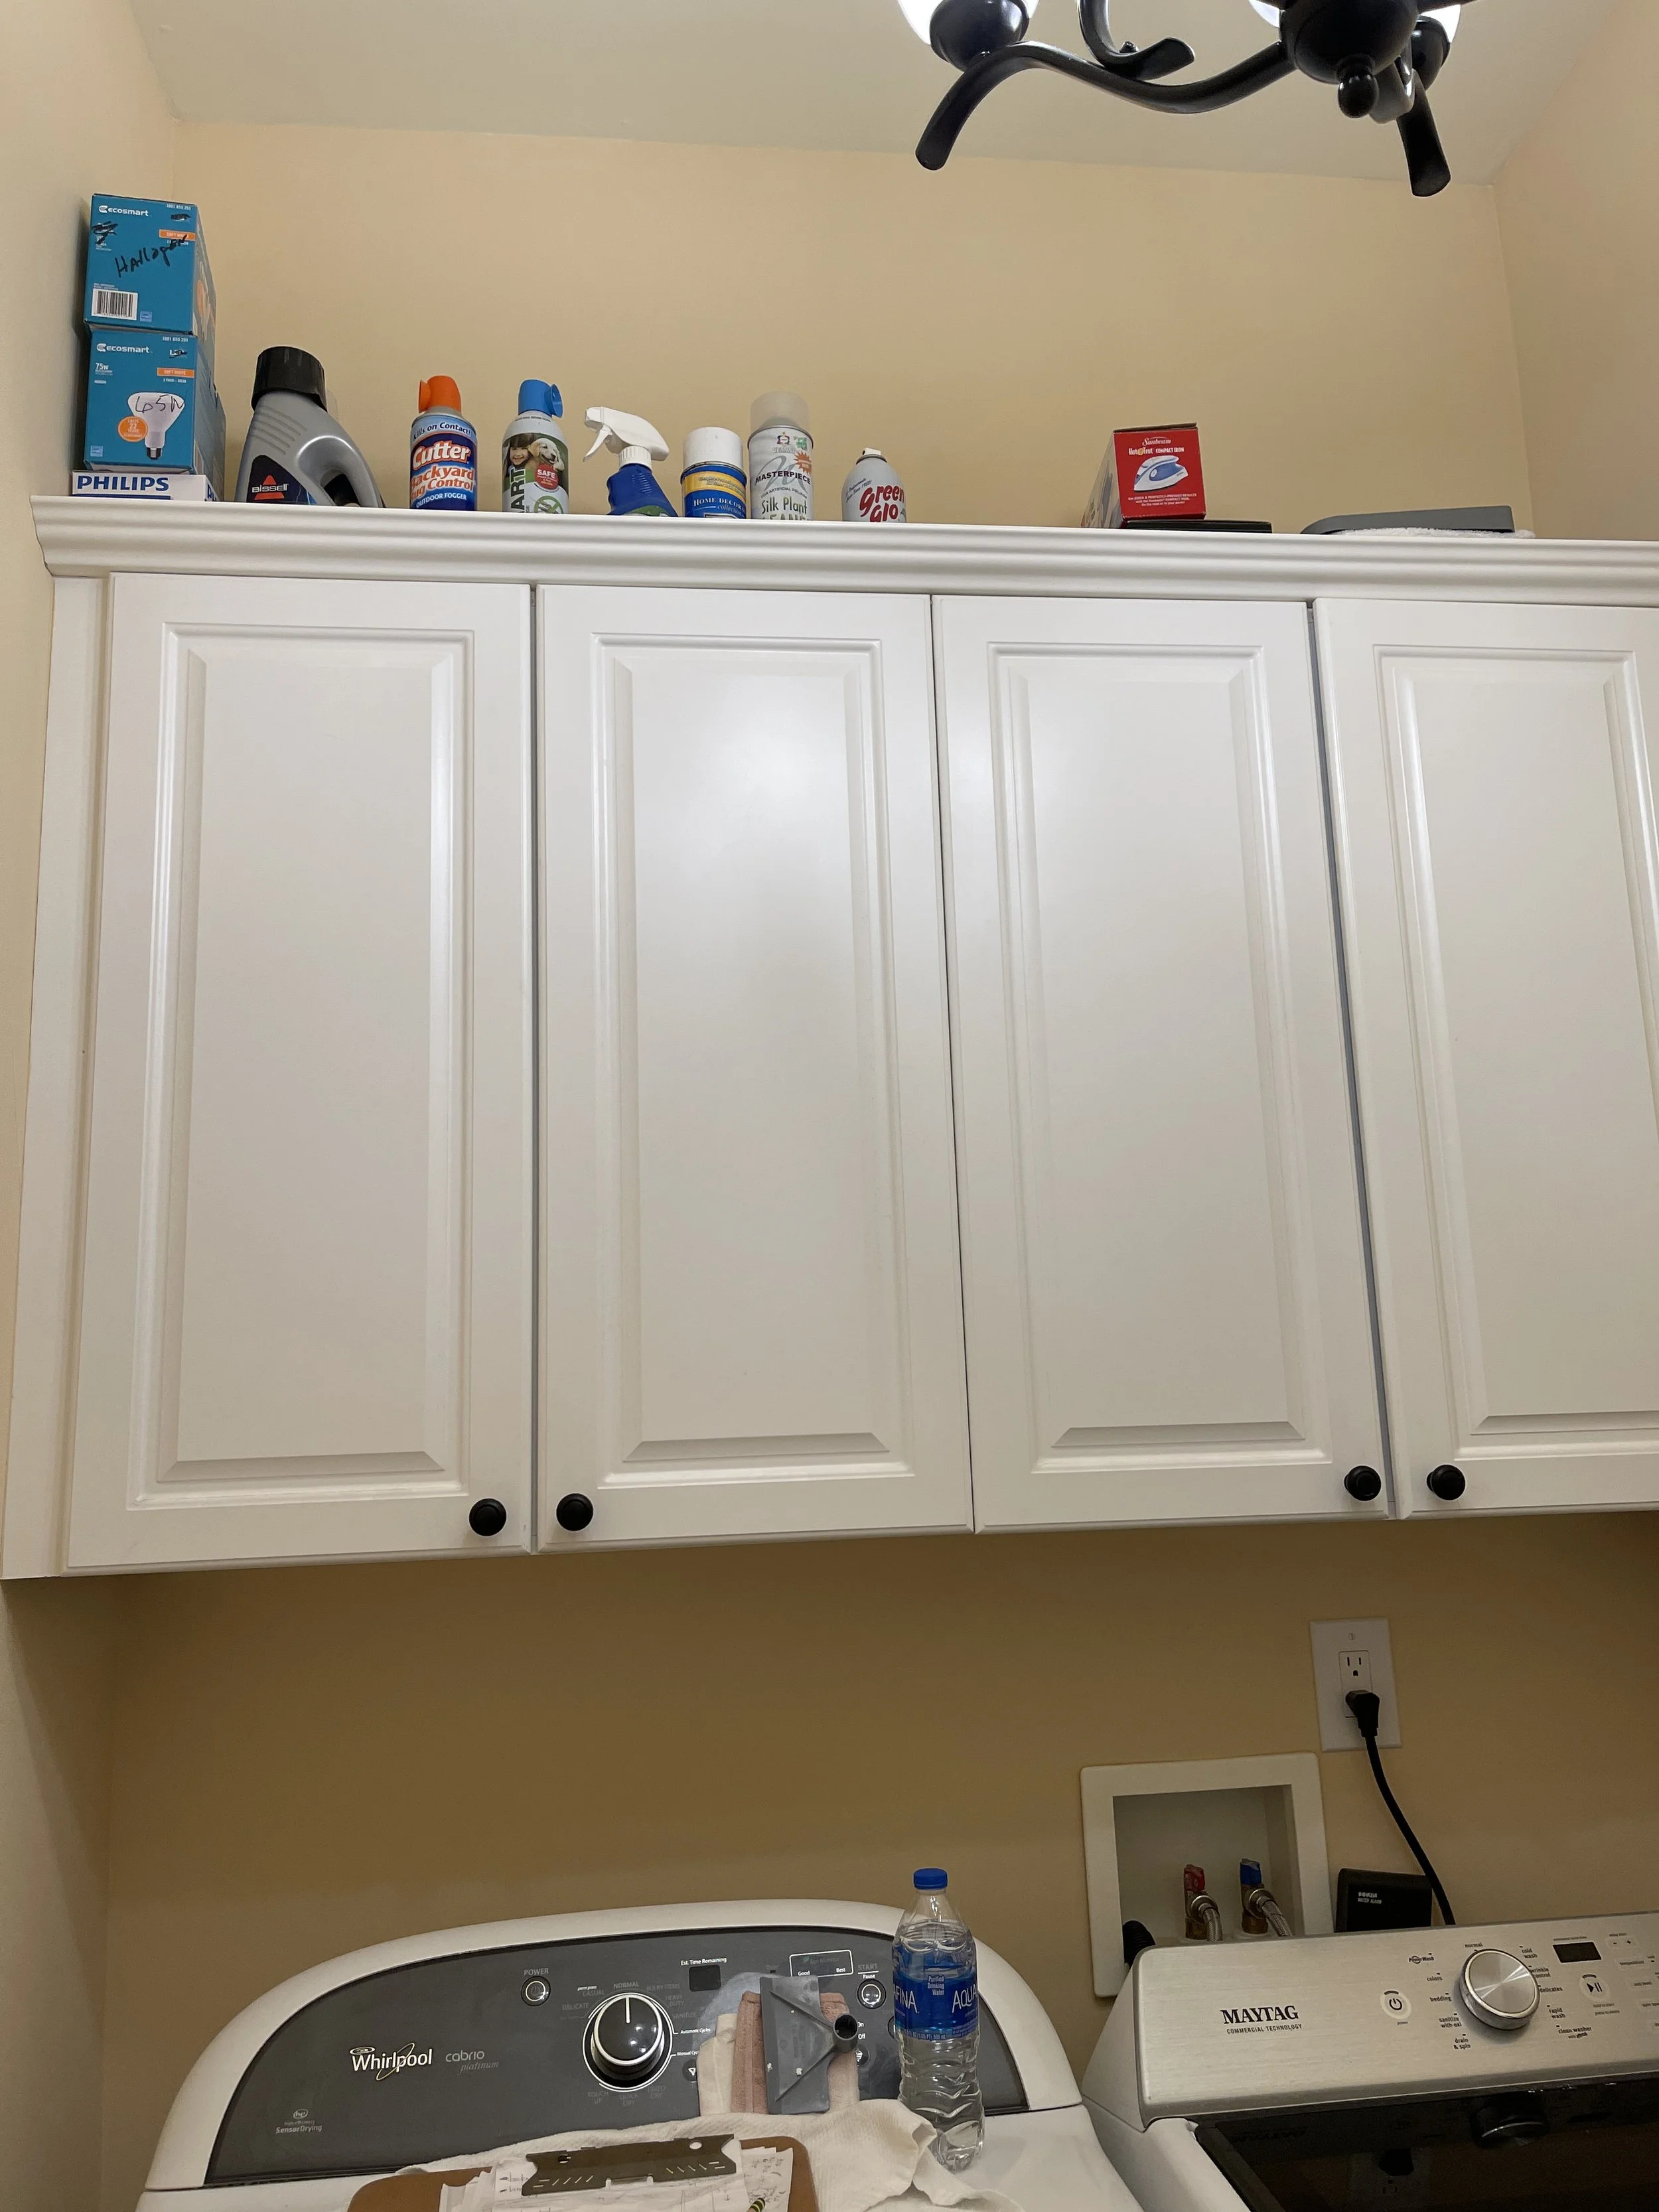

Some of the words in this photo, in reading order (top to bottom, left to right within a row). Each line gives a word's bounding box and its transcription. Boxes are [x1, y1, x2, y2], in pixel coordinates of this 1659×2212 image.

[108, 207, 149, 216] ecosmart
[413, 427, 425, 441] Kills
[439, 422, 470, 435] Contact!
[1142, 437, 1171, 447] Sunbeam
[412, 441, 470, 470] Cutter
[537, 469, 556, 479] SAFE
[755, 471, 811, 484] MASTERPIECE
[77, 475, 170, 492] PHILIPS
[427, 478, 472, 491] Control
[510, 467, 525, 512] ART
[416, 493, 443, 508] OUTDOOR
[445, 492, 467, 501] FOGGER
[693, 497, 717, 507] HOME
[761, 496, 779, 514] Silk
[782, 496, 808, 514] Plant
[859, 484, 904, 518] Green
[869, 502, 899, 522] Glo
[952, 1984, 977, 2014] AQUA
[1220, 2005, 1299, 2025] MAYTAG
[1226, 2026, 1265, 2034] COMMERCIAL
[352, 2048, 433, 2073] Whirlpool
[445, 2049, 485, 2063] cabrio
[457, 2061, 499, 2076] platinum
[275, 2125, 323, 2134] SensorDrying
